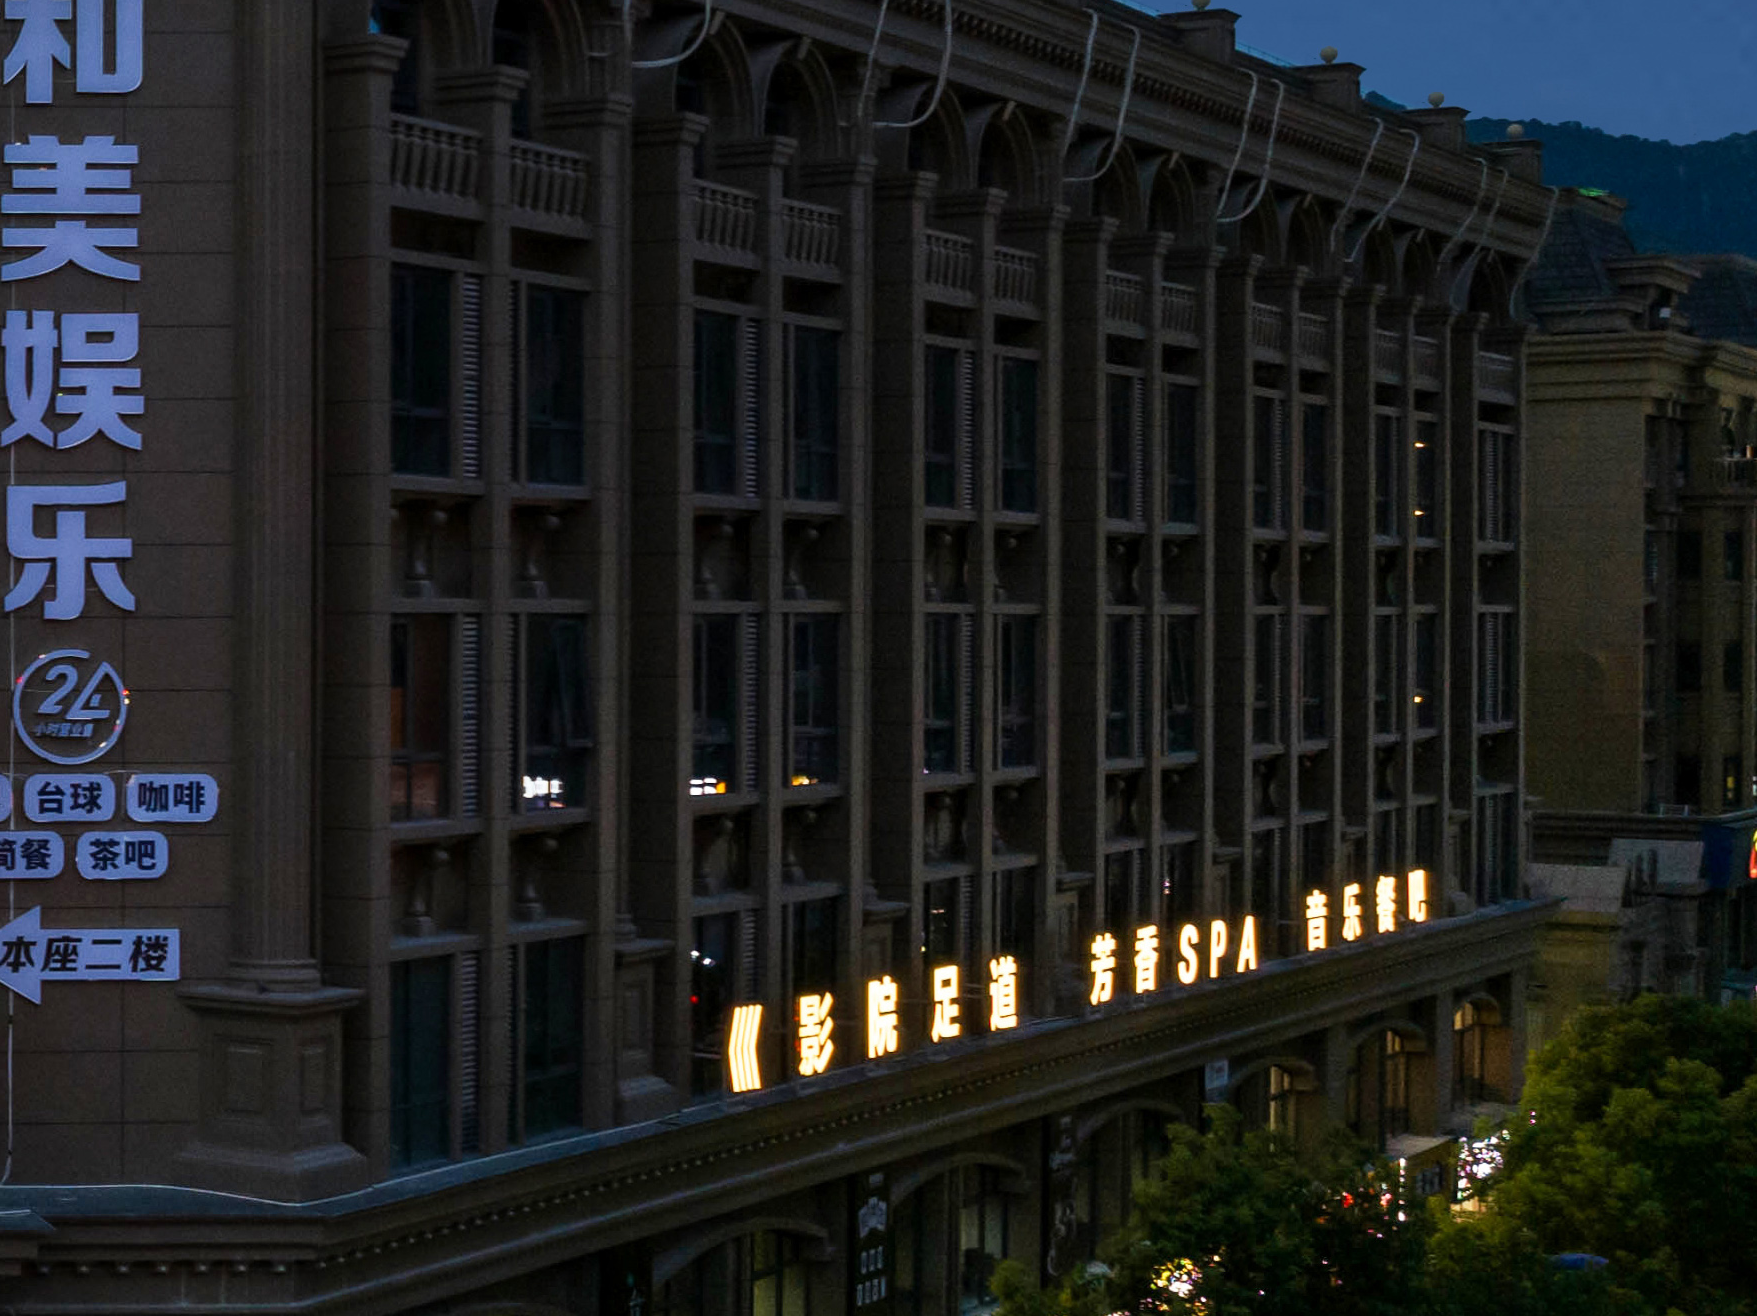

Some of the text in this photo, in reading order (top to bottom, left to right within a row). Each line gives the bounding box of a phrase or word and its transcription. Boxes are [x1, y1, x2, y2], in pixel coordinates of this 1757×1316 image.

[37, 661, 111, 720] 24
[36, 781, 103, 814] 台球
[138, 781, 205, 814] 咖啡
[89, 838, 157, 872] 茶吧
[798, 869, 1428, 1076] 影院足道 芳香SPA 音乐餐吧
